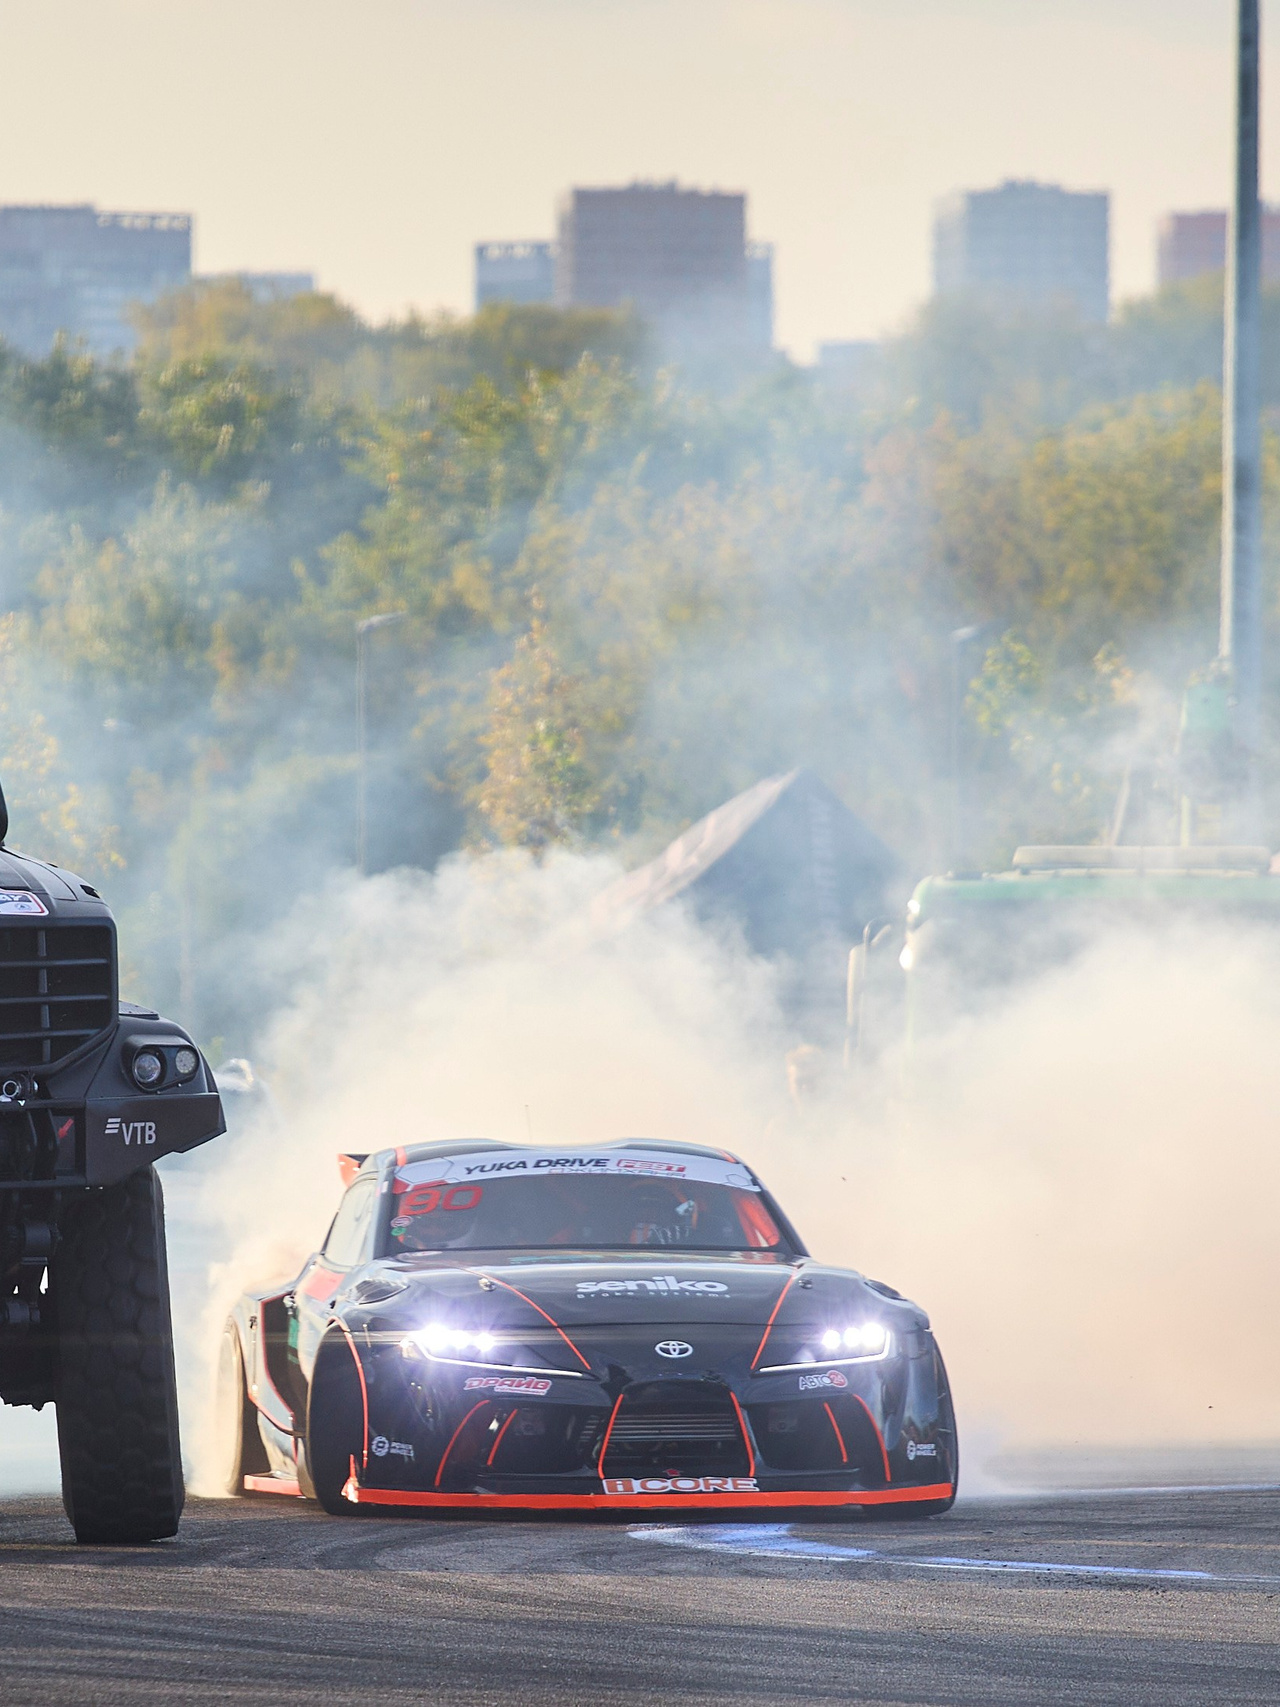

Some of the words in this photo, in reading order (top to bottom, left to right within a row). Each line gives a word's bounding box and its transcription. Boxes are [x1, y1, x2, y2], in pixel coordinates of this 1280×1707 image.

[122, 1121, 157, 1146] VTB
[464, 1160, 528, 1176] YUKA
[532, 1157, 611, 1169] DRIVE
[616, 1159, 686, 1173] FEST
[398, 1185, 484, 1216] 90
[575, 1275, 729, 1292] seniko
[463, 1376, 552, 1391] ДРАЙВ
